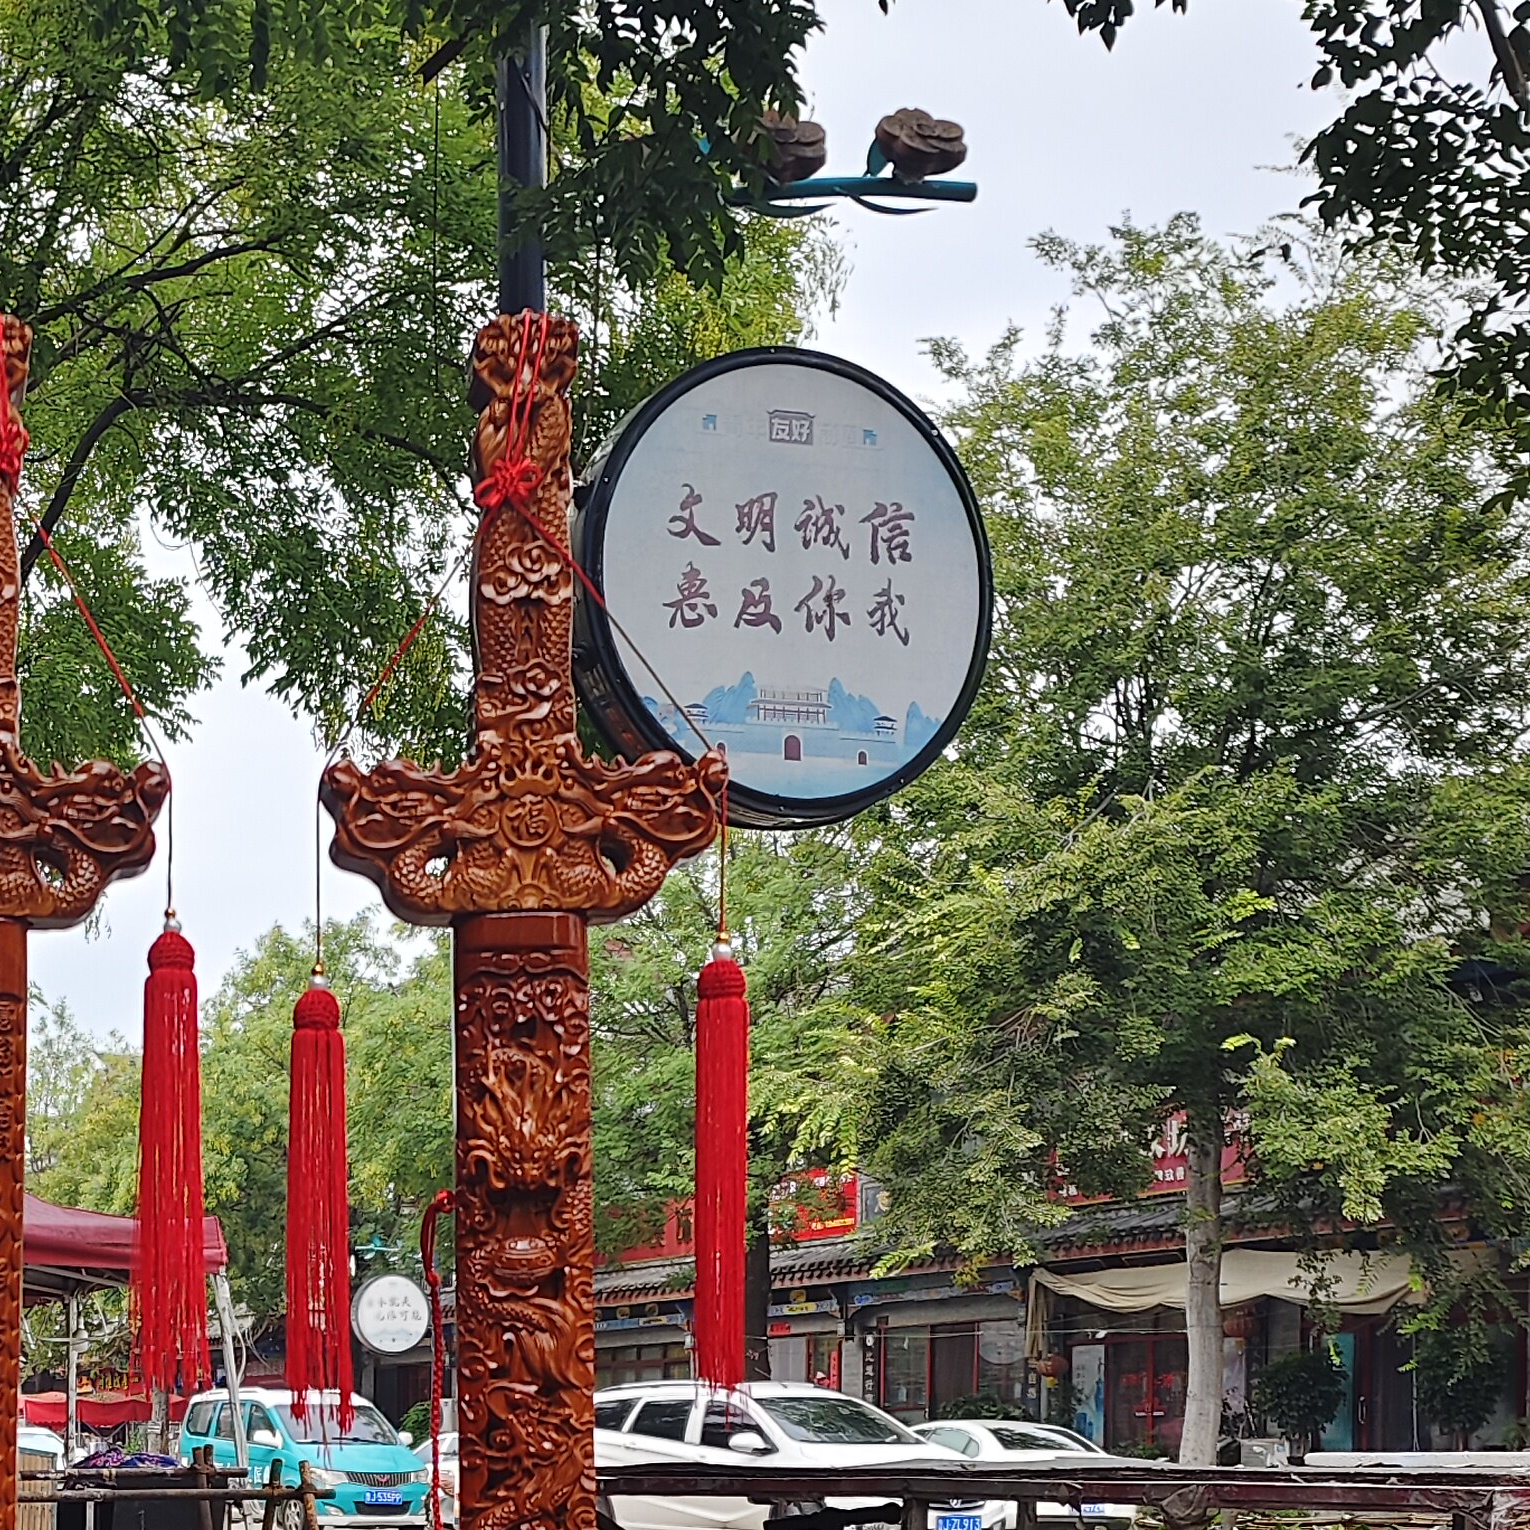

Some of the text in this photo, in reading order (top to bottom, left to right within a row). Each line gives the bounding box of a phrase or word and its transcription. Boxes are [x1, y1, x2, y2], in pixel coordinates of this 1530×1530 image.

[771, 417, 811, 442] 友好
[667, 483, 915, 565] 文明诚信
[662, 561, 911, 646] 惠及你我
